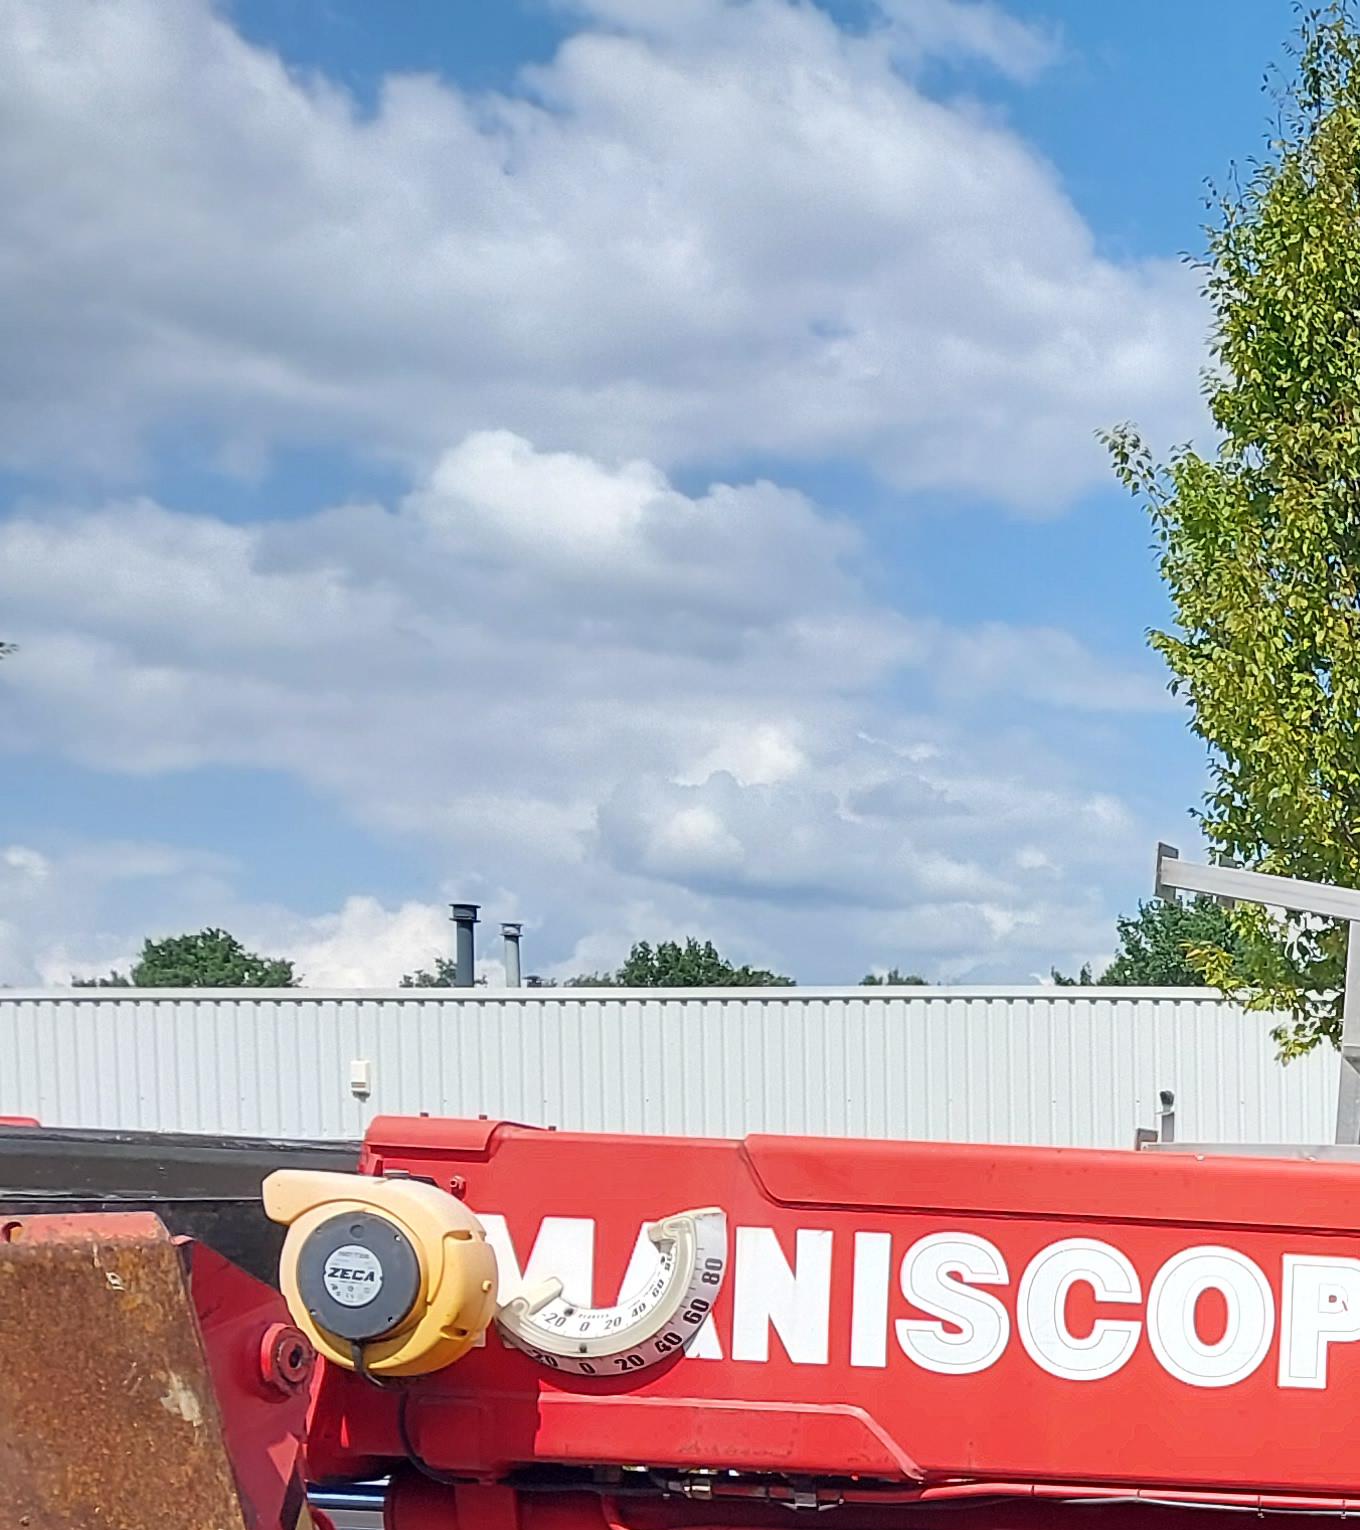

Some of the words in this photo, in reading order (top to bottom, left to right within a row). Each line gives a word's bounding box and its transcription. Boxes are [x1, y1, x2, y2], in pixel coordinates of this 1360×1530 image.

[327, 1267, 375, 1282] ZECA
[579, 1362, 596, 1374] 0
[614, 1354, 645, 1371] 20
[654, 1331, 683, 1353] 40
[682, 1298, 710, 1325] 60
[701, 1258, 724, 1285] 80
[604, 1316, 622, 1330] 20
